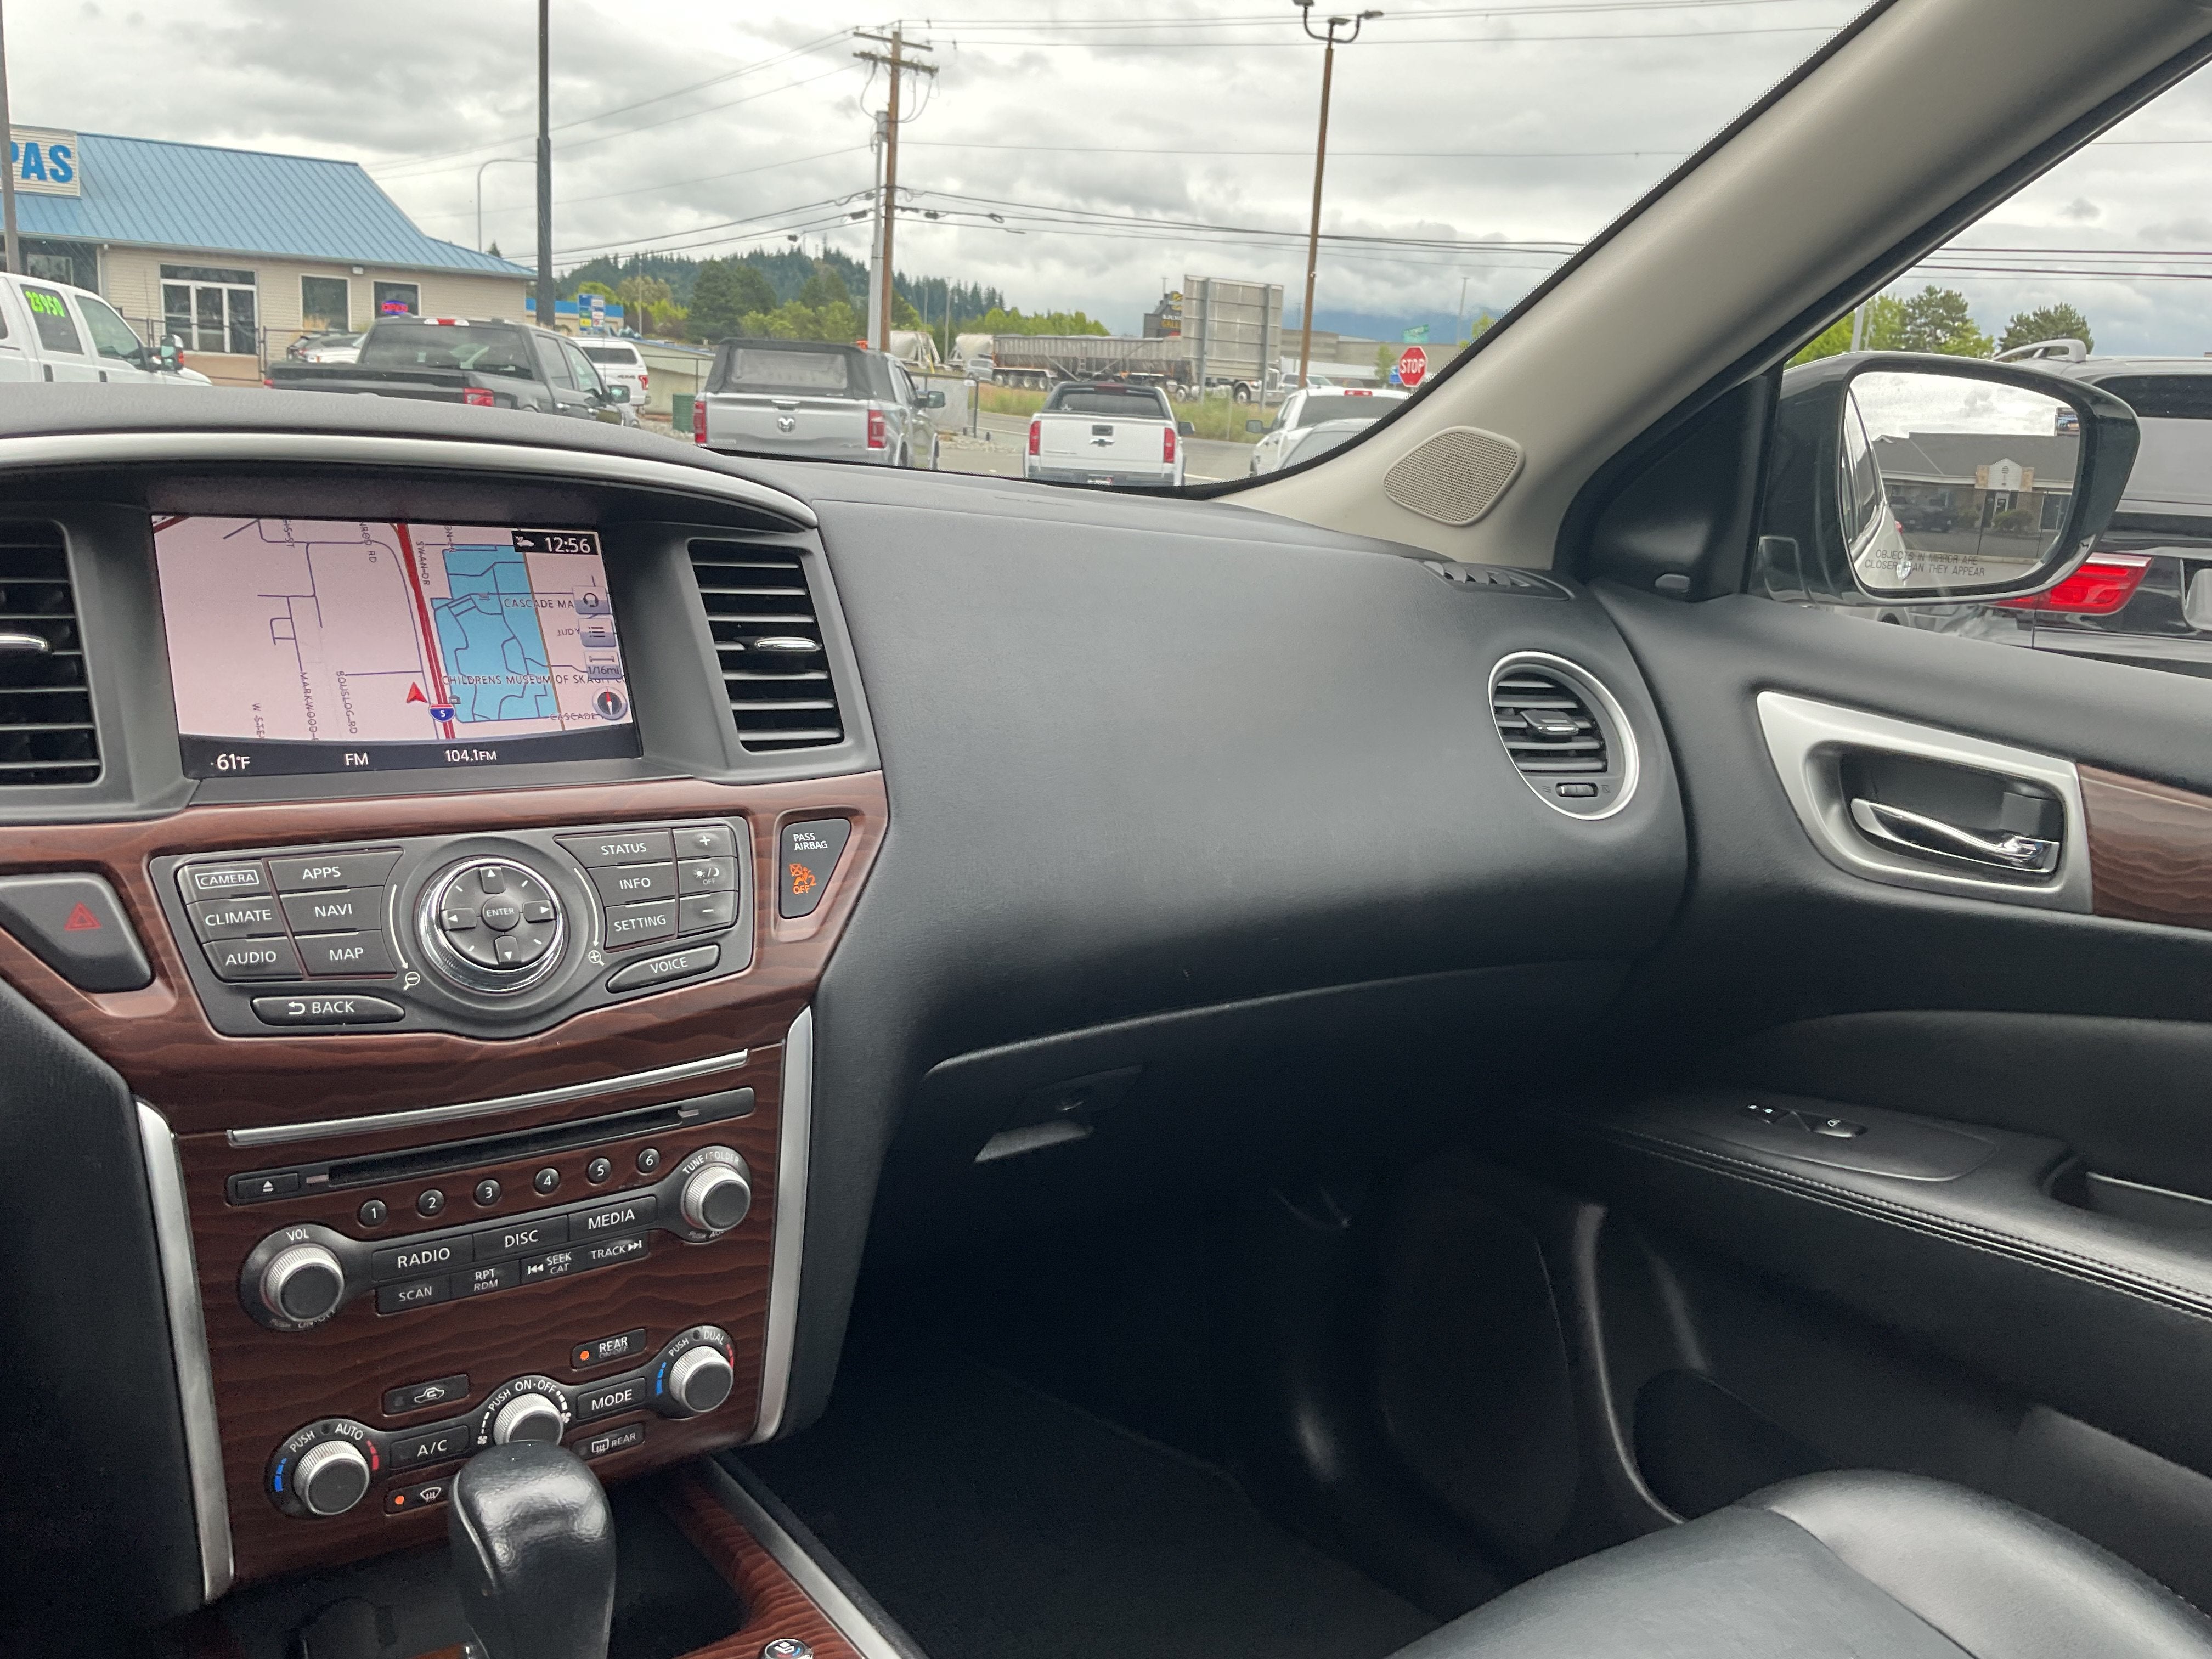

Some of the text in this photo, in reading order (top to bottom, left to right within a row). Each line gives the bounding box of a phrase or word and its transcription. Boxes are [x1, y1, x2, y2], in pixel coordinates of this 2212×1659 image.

[1400, 358, 1425, 374] STOP
[545, 537, 591, 554] 12:56
[416, 541, 431, 585] SWAN DR
[1875, 549, 1978, 566] OBJECTS IN MIRROR ARE
[1864, 558, 1898, 570] CLOSER
[1928, 563, 1948, 574] THEY
[1951, 566, 1985, 577] APPEAR
[504, 599, 554, 608] CASCADE
[557, 628, 580, 637] JUDY
[588, 665, 620, 675] 1/16mi
[442, 675, 501, 685] CHILDRENS
[506, 675, 551, 684] MUSEUM
[556, 675, 569, 684] OF
[252, 702, 261, 711] W
[299, 672, 318, 733] MARKWOOD
[348, 721, 358, 734] RD
[345, 753, 369, 766] FM
[793, 832, 815, 842] PASS
[601, 843, 647, 855] STATUS
[795, 840, 828, 850] AIRBAG
[302, 866, 341, 879] APPS
[200, 873, 255, 887] CAMERA
[619, 877, 651, 890] INFO
[793, 885, 810, 894] OFF
[314, 904, 352, 917] NAVI
[486, 907, 515, 917] ENTER
[205, 909, 272, 926] CLIMATE
[614, 915, 667, 932] SETTING
[225, 951, 277, 966] AUDIO
[329, 947, 364, 961] MAP
[650, 957, 689, 974] VOICE
[312, 1001, 356, 1014] BACK
[646, 1155, 653, 1166] 6
[597, 1165, 605, 1176] 5
[543, 1175, 552, 1186] 4
[484, 1187, 493, 1198] 3
[428, 1197, 437, 1209] 2
[371, 1207, 377, 1218] 1
[588, 1209, 635, 1230] MEDIA
[286, 1229, 309, 1242] VOL
[505, 1229, 539, 1248] DISC
[398, 1247, 451, 1268] RADIO
[546, 1252, 572, 1266] SEEK
[591, 1245, 626, 1260] TRACK
[475, 1268, 495, 1281] RPT
[550, 1263, 569, 1275] CAT
[473, 1279, 499, 1291] RDM
[399, 1286, 433, 1302] SCAN
[599, 1336, 628, 1353] REAR
[668, 1330, 724, 1357] PUSH DUAL
[488, 1389, 511, 1412] PUSH
[591, 1389, 633, 1410] MODE
[289, 1423, 363, 1453] PUSH AUTO
[611, 1432, 636, 1447] REAR
[417, 1440, 448, 1457] A/C
